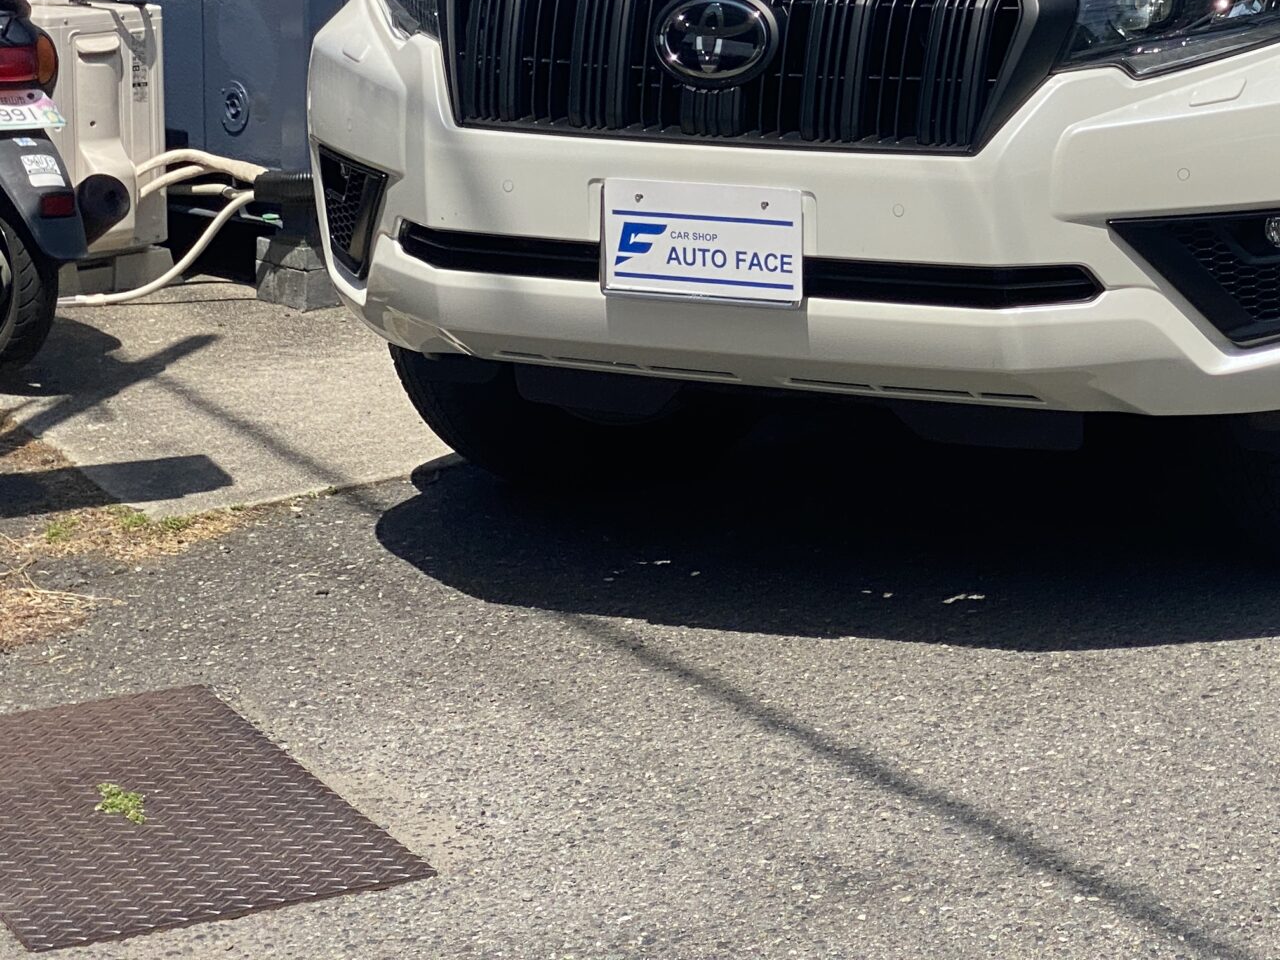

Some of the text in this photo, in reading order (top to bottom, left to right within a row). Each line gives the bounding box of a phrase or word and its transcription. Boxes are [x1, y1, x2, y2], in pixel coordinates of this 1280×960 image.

[669, 230, 718, 242] CAR SHOP
[666, 246, 794, 274] AUTO FACE
